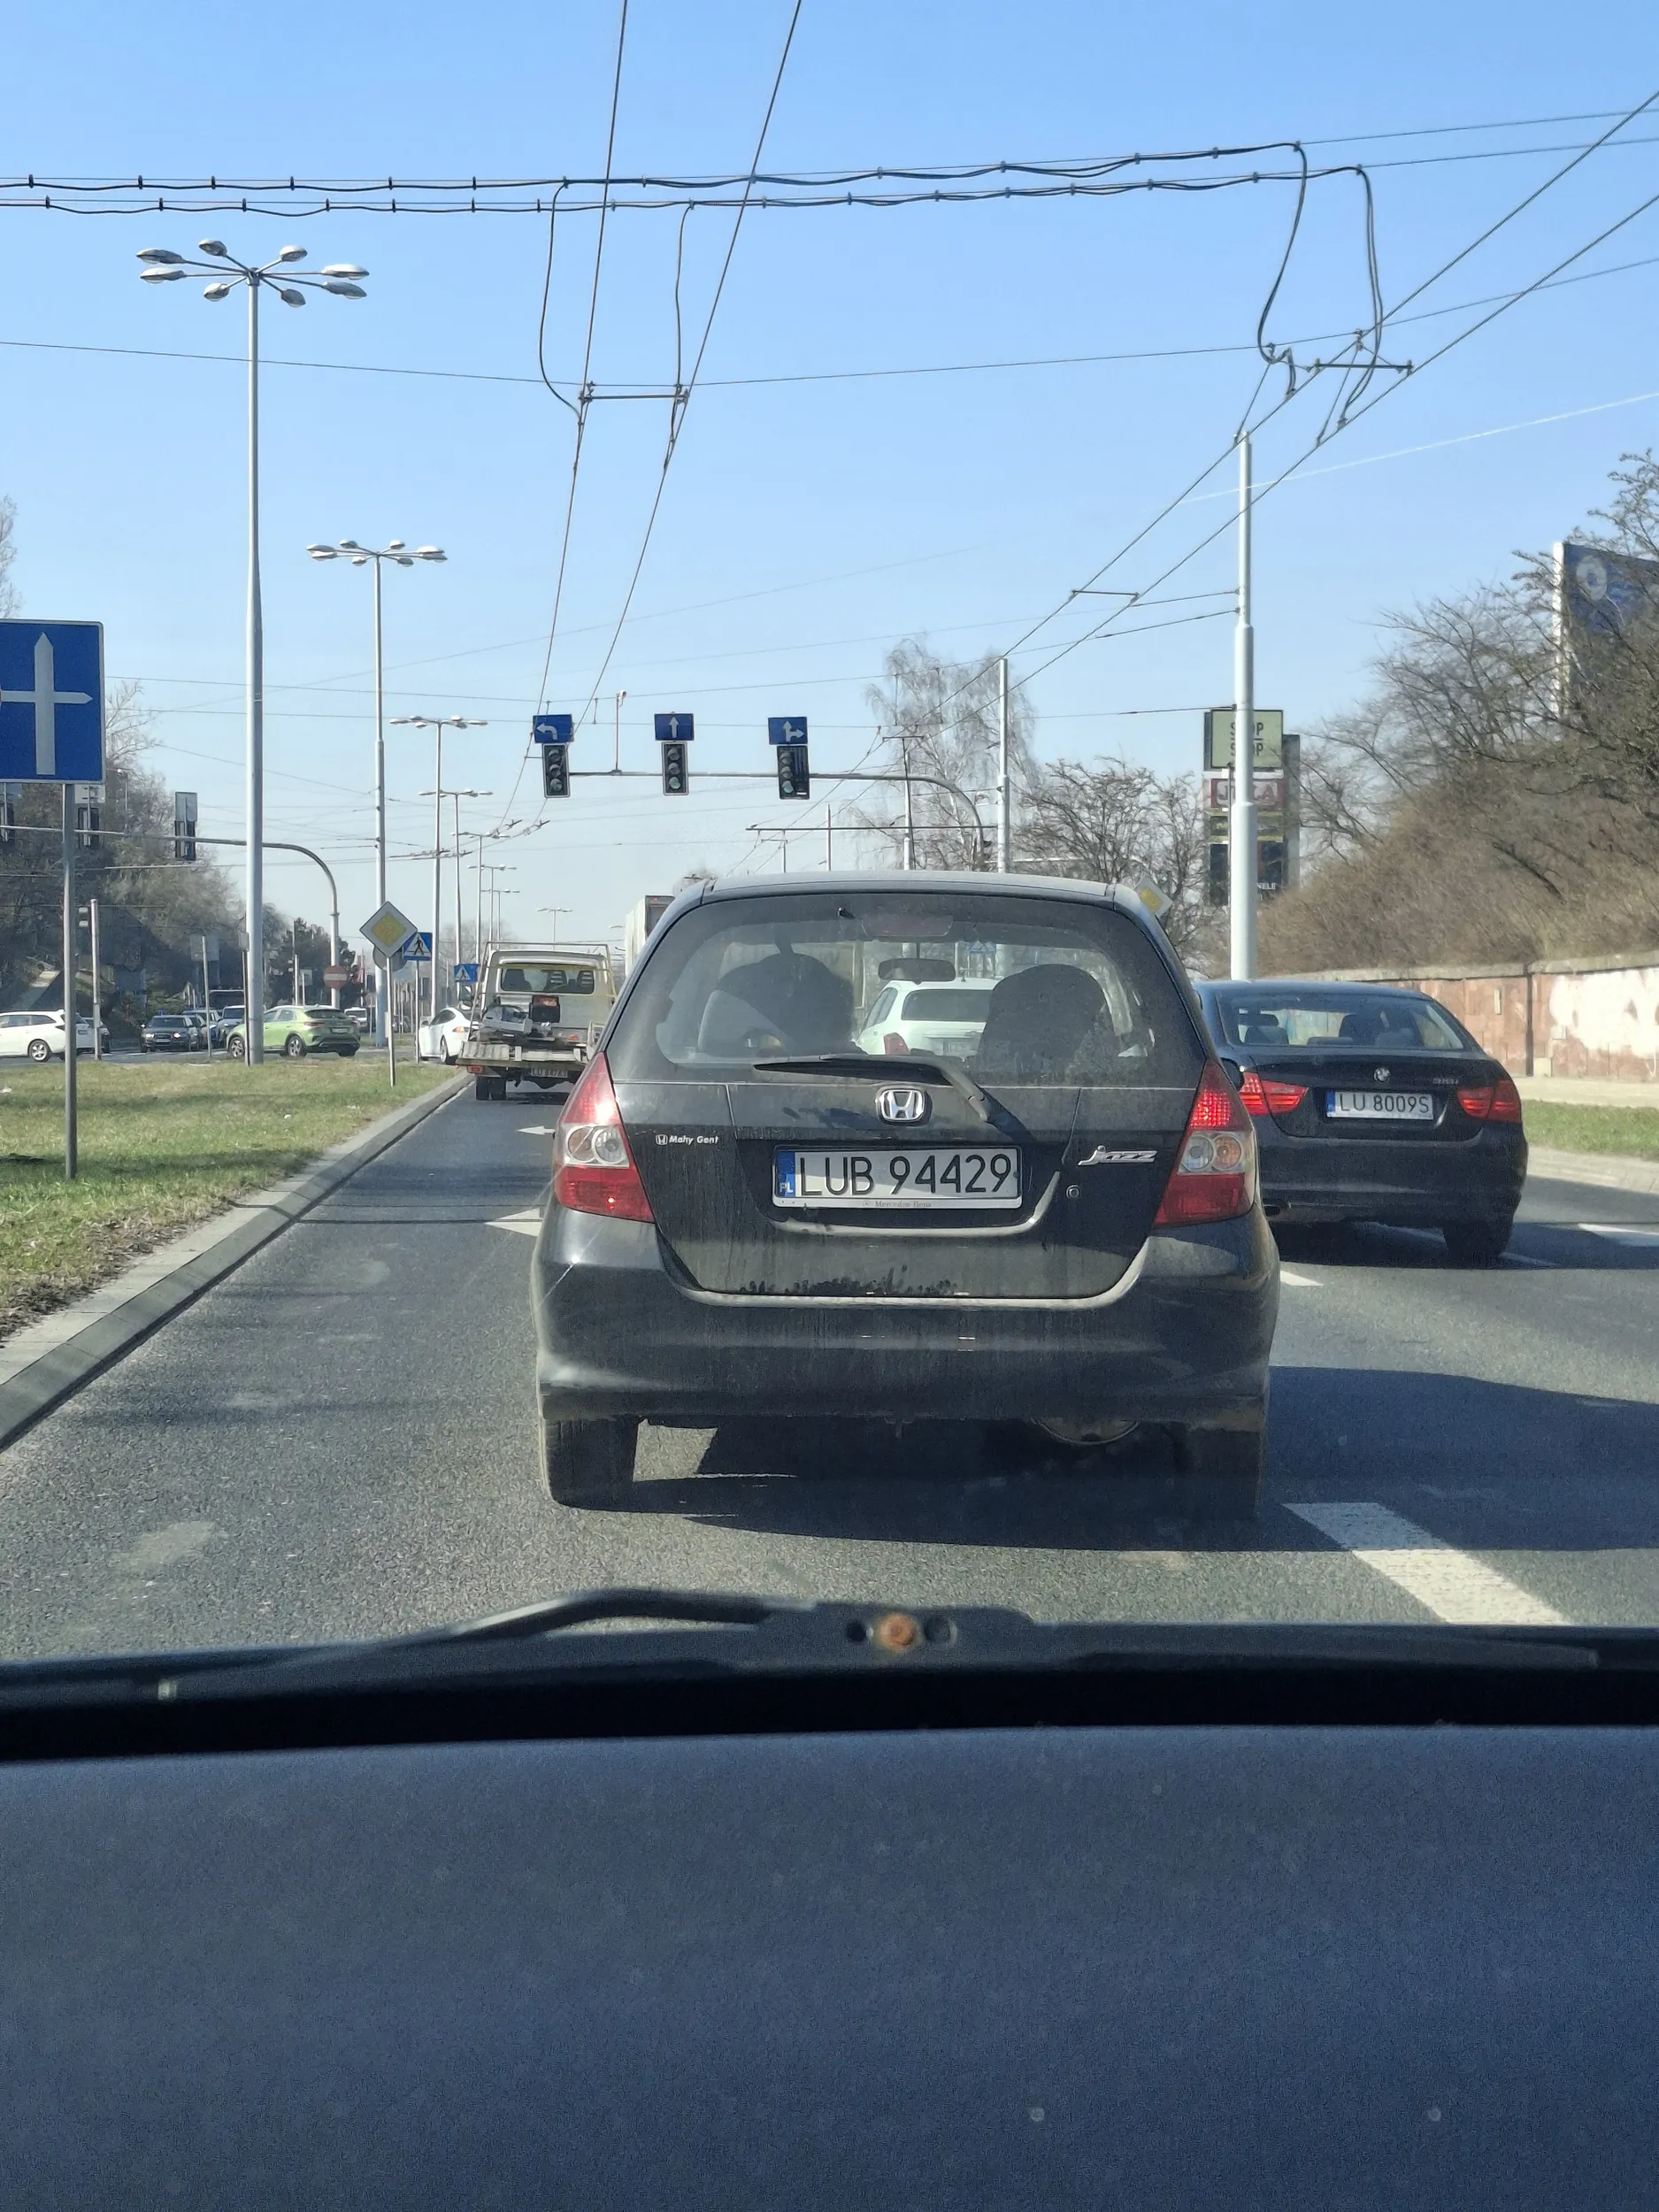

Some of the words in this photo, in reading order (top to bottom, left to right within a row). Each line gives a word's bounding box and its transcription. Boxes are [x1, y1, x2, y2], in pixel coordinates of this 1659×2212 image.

[1340, 1094, 1366, 1112] LU
[1373, 1094, 1430, 1113] 8009S
[669, 1135, 694, 1146] Mahy
[696, 1135, 719, 1144] Gent
[800, 1156, 873, 1196] LUB
[889, 1154, 1012, 1194] 94429
[780, 1182, 794, 1194] PL
